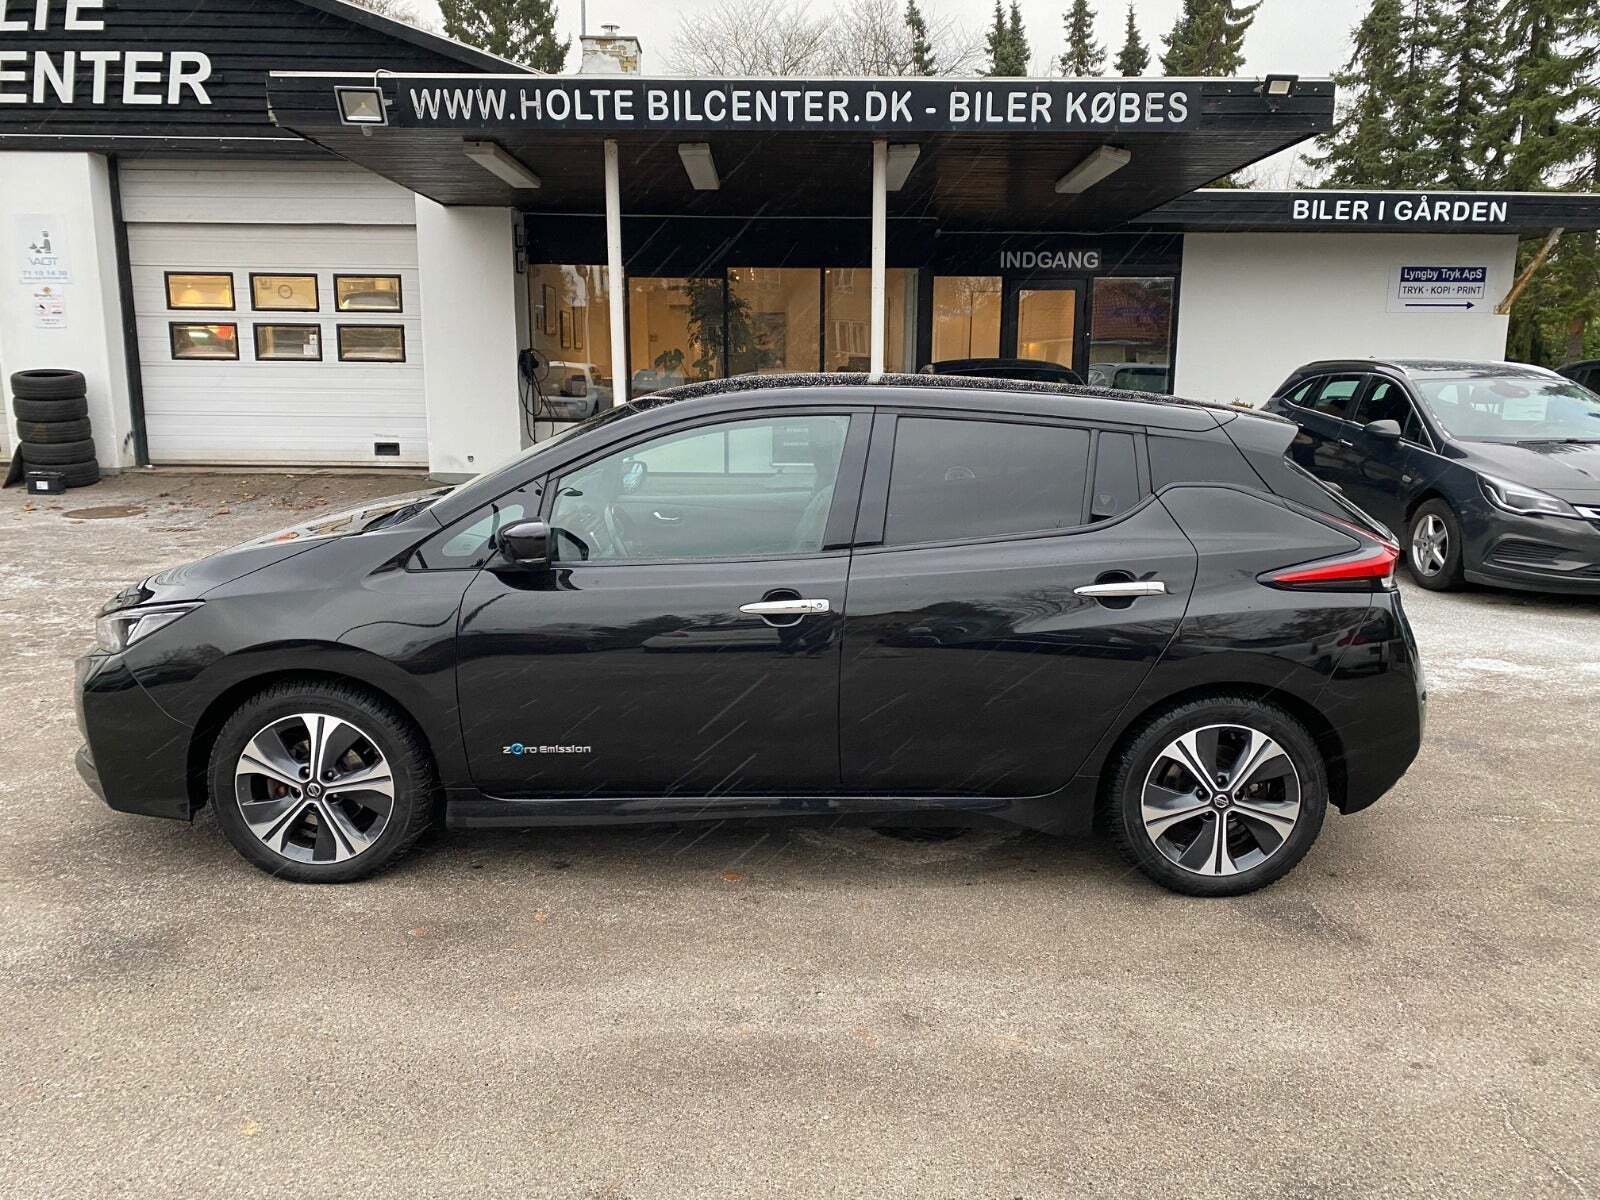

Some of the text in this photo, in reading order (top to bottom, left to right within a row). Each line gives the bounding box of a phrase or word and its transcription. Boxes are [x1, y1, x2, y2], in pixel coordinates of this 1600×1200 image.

[409, 88, 635, 121] WWW.HOLTE
[647, 89, 913, 123] BILCENTER.DK
[949, 91, 1053, 124] BILER
[1065, 89, 1188, 125] KØBES
[1292, 195, 1508, 222] BILER I GÅRDEN
[1000, 251, 1100, 269] INDGANG
[1404, 268, 1483, 281] Lyngby Tryk ApS
[1402, 286, 1482, 295] TRYK KOPI PRINT
